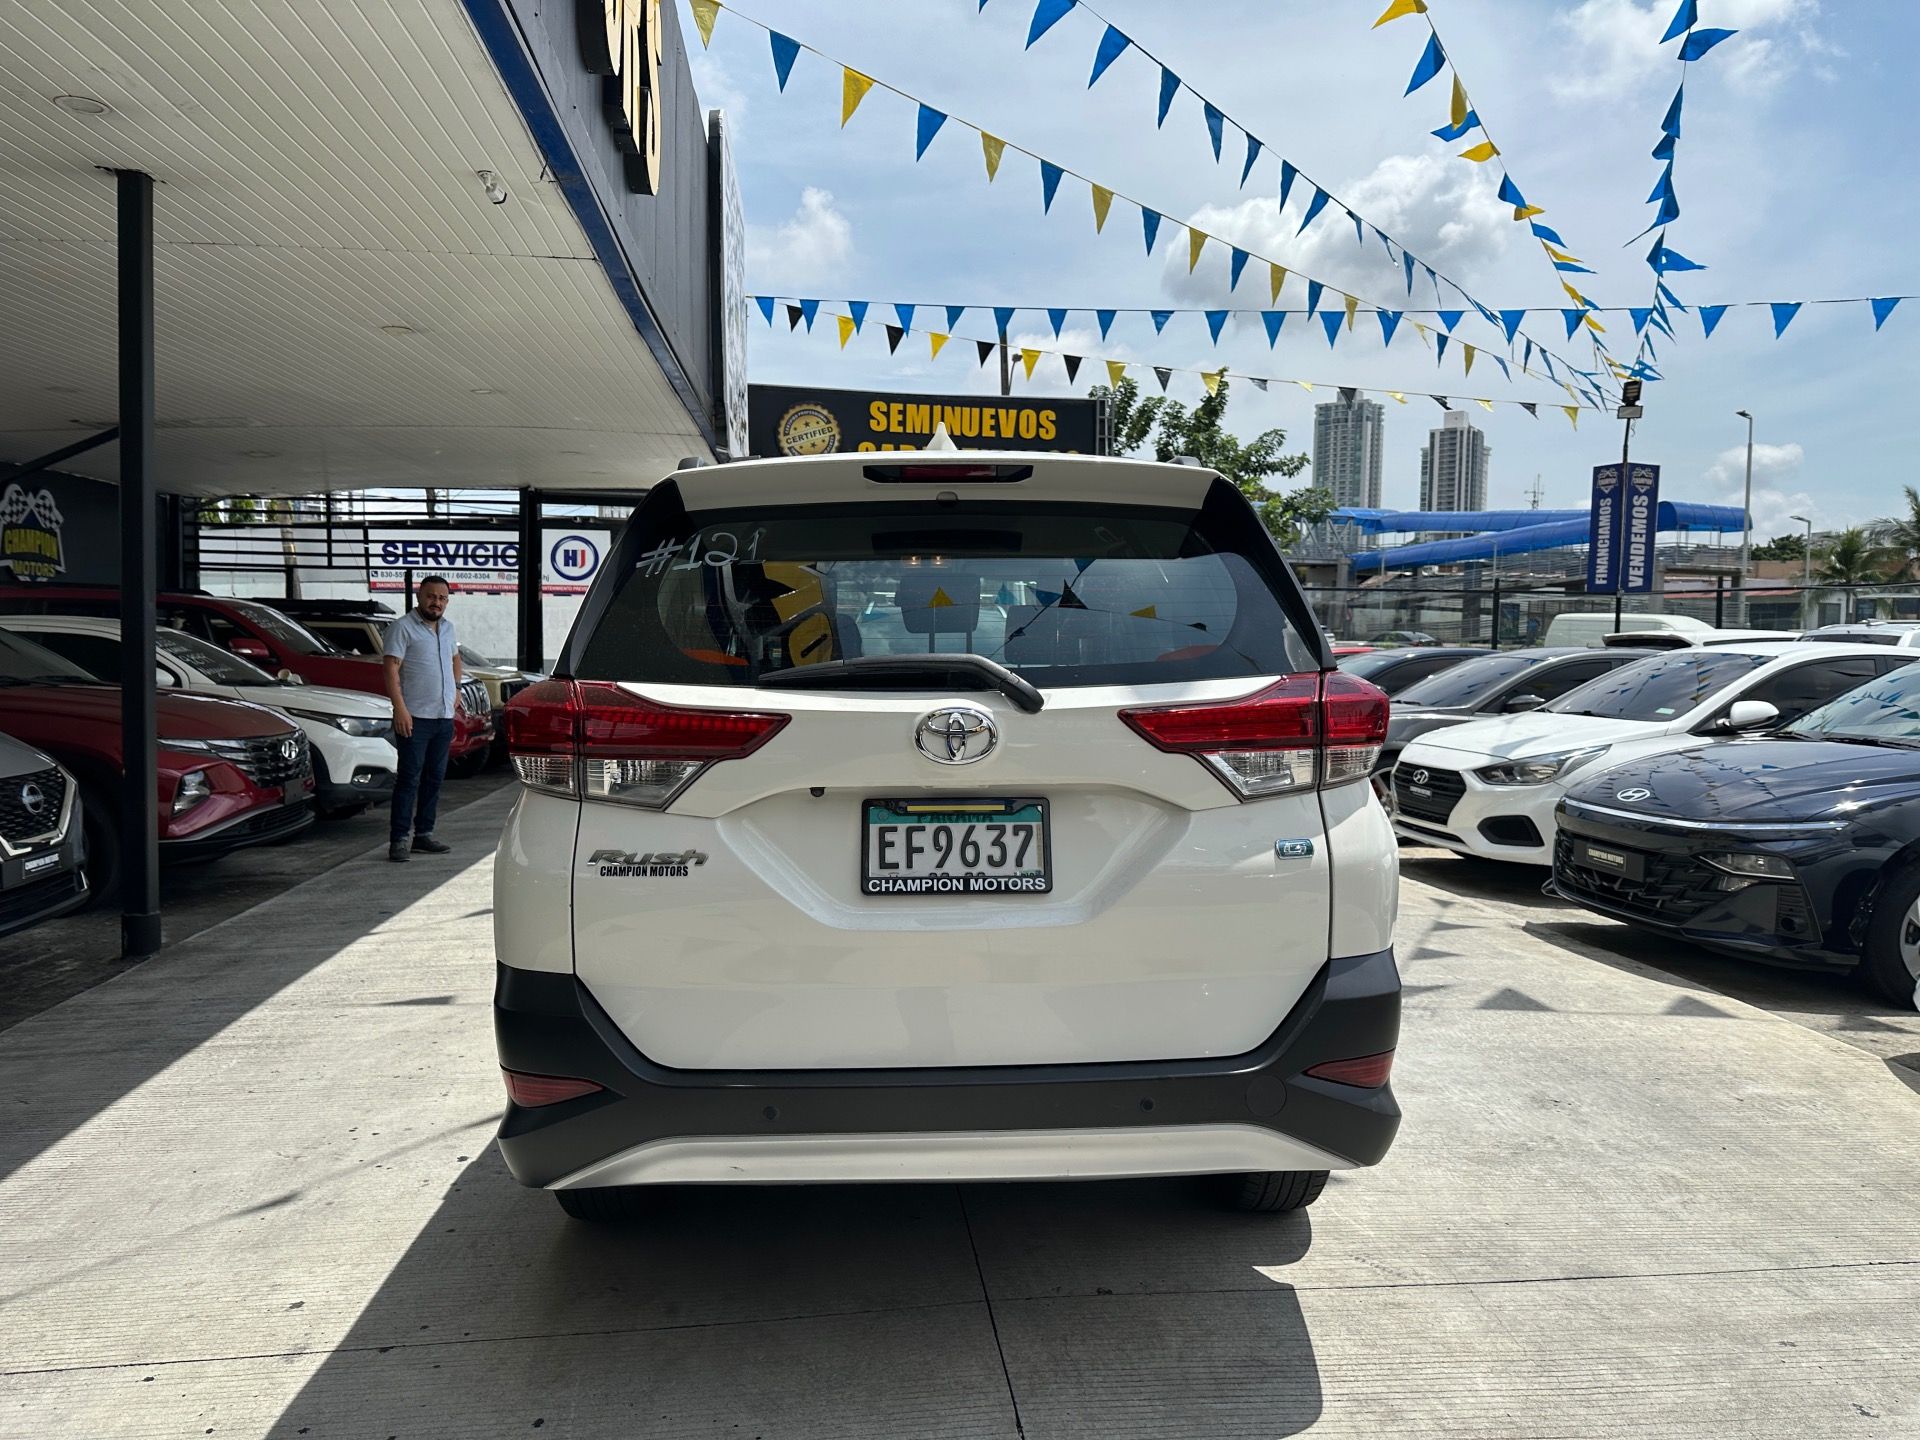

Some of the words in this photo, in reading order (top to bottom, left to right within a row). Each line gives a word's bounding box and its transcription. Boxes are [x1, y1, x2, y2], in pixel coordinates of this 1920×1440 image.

[869, 401, 1056, 439] SEMINUEVOS
[785, 426, 833, 445] CERTIFIED
[635, 528, 767, 577] #121
[1595, 497, 1612, 585] FINANCIAMOS
[1628, 495, 1649, 587] VENDEMOS
[563, 549, 586, 568] HJ
[587, 849, 709, 866] Rush
[878, 825, 1034, 869] EF9637
[600, 866, 648, 877] CHAMPION
[650, 866, 689, 877] MOTORS
[868, 879, 964, 892] CHAMPION
[970, 878, 1046, 891] MOTORS
